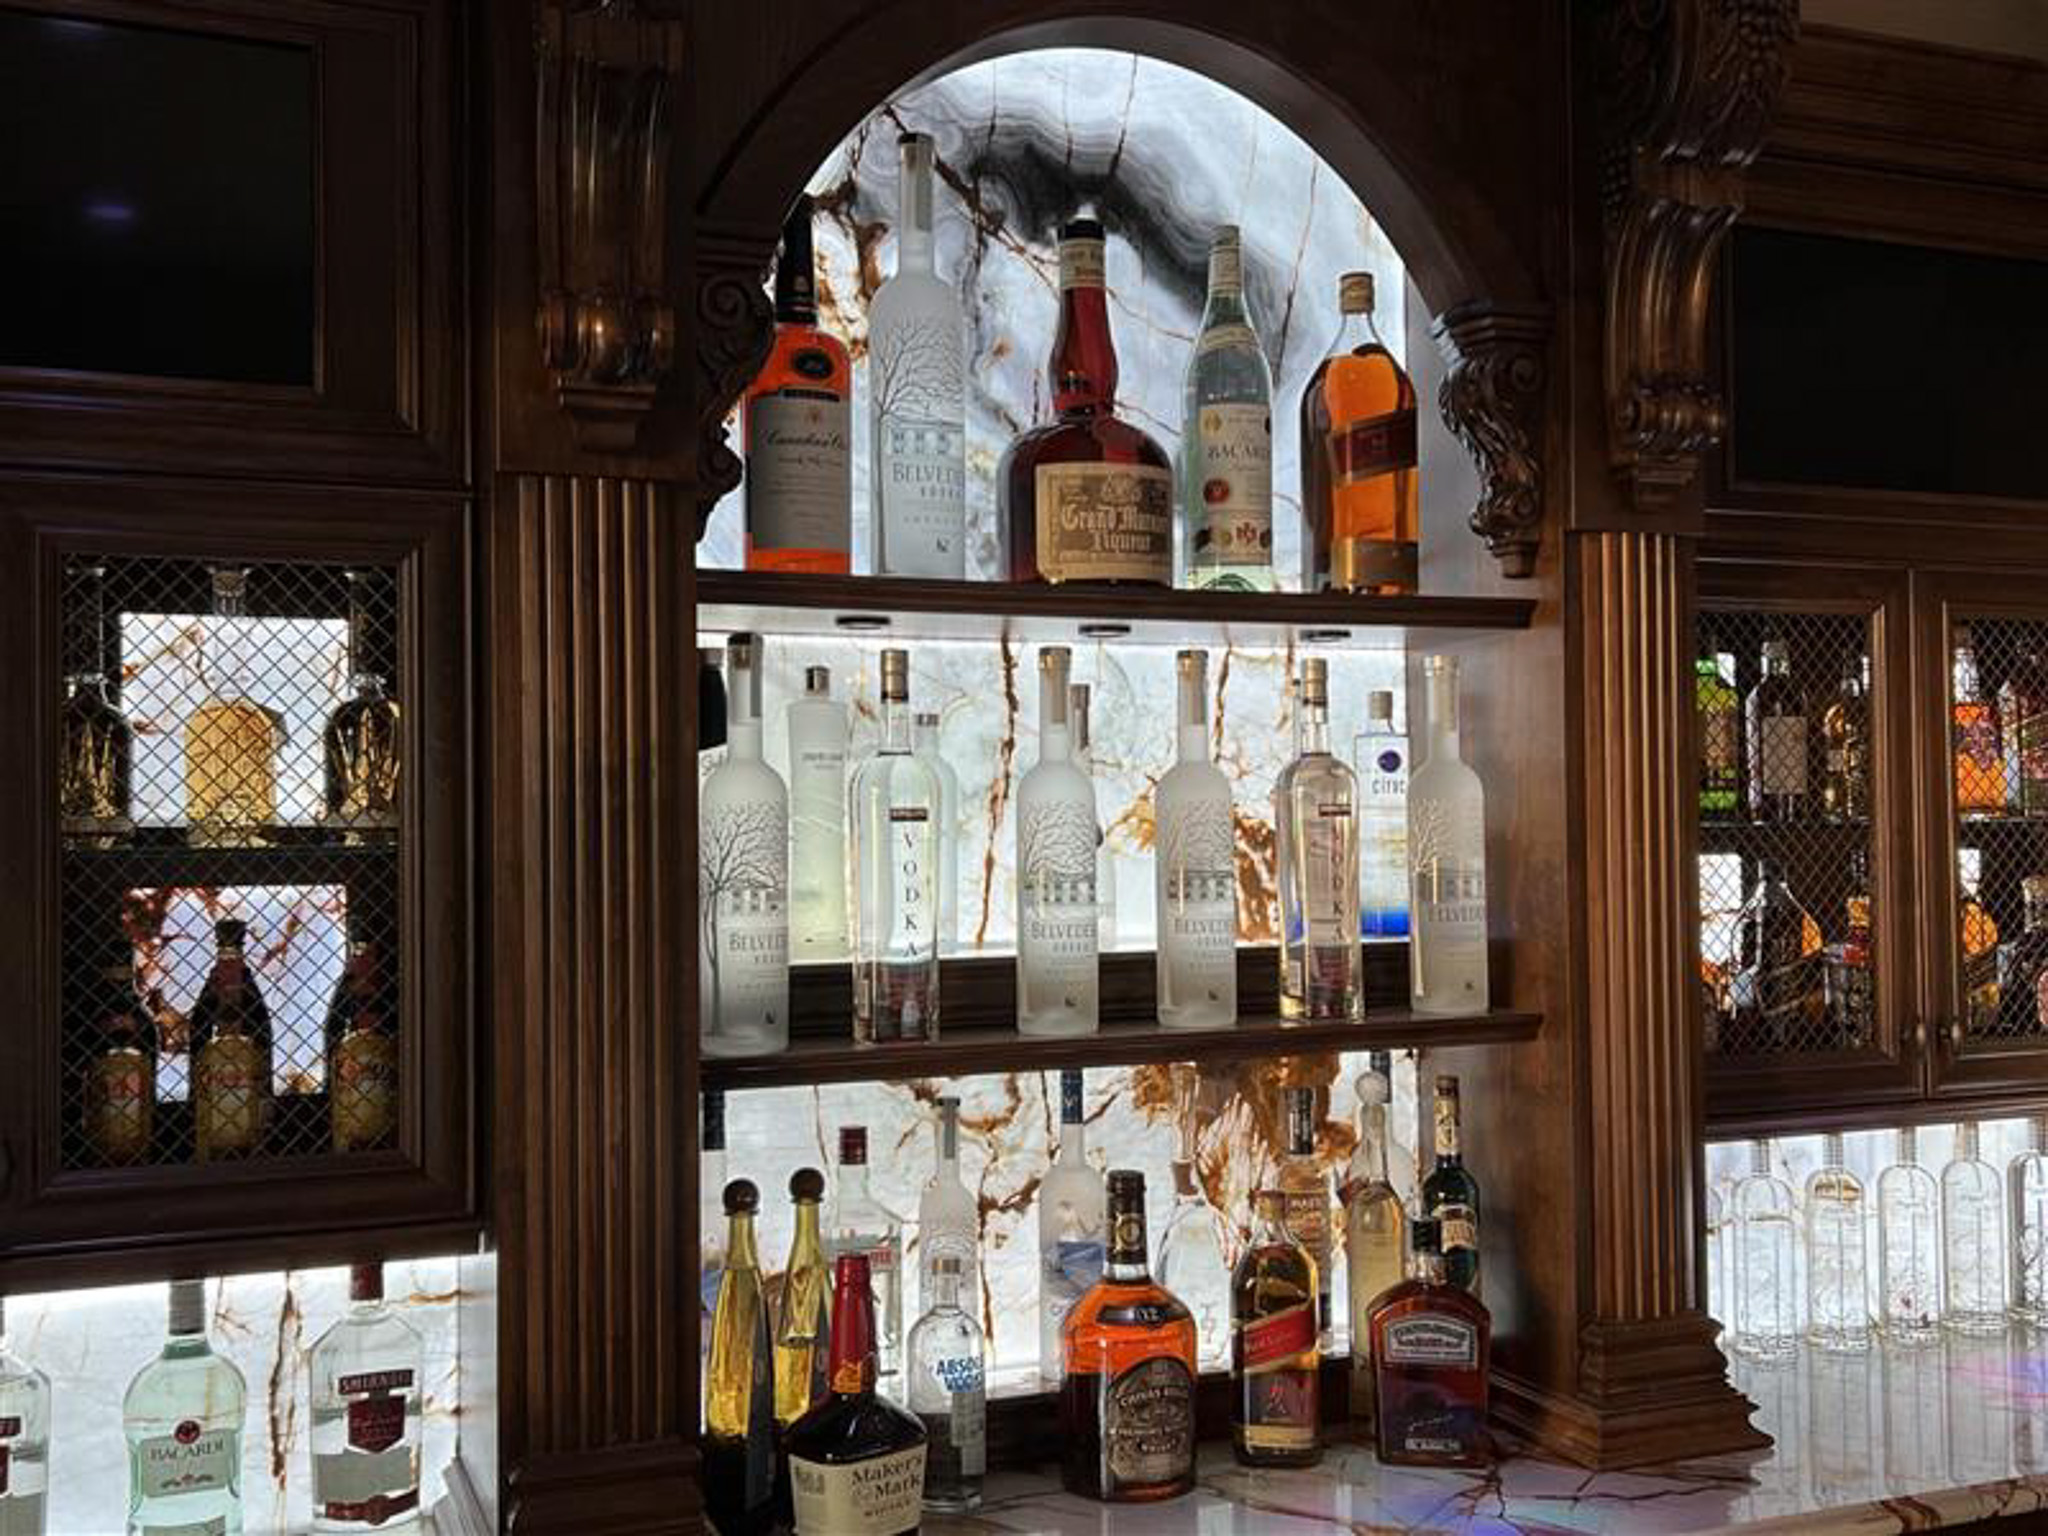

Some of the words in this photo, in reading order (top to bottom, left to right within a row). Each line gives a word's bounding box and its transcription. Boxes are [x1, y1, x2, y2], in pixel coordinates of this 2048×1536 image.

[903, 832, 921, 957] VODKA
[150, 1438, 224, 1461] BACARDI
[874, 1475, 921, 1500] Mark
